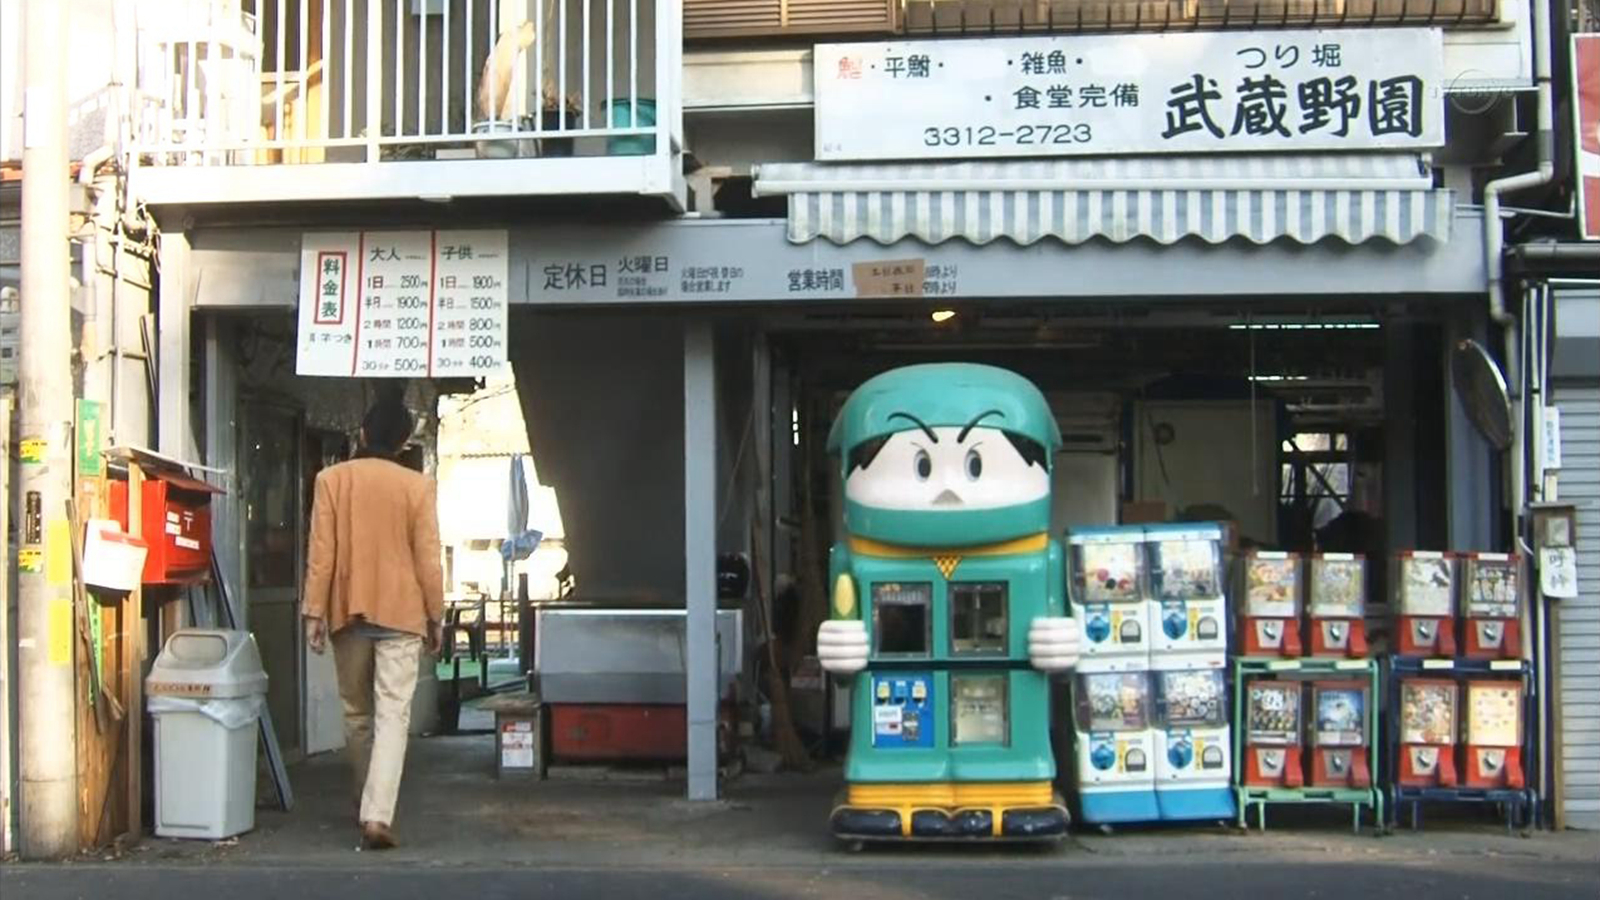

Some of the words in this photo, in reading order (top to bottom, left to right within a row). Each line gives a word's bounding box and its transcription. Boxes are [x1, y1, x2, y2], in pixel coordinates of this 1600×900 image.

[1236, 43, 1341, 69] つり堀
[1160, 73, 1424, 141] 武蔵野園
[924, 123, 1092, 147] 3312-2723
[369, 245, 401, 262] 大人
[441, 244, 473, 261] 子供
[617, 255, 669, 274] 火曜日
[321, 257, 340, 318] 料金表
[543, 263, 607, 291] 定休日
[787, 268, 844, 292] 営業時間
